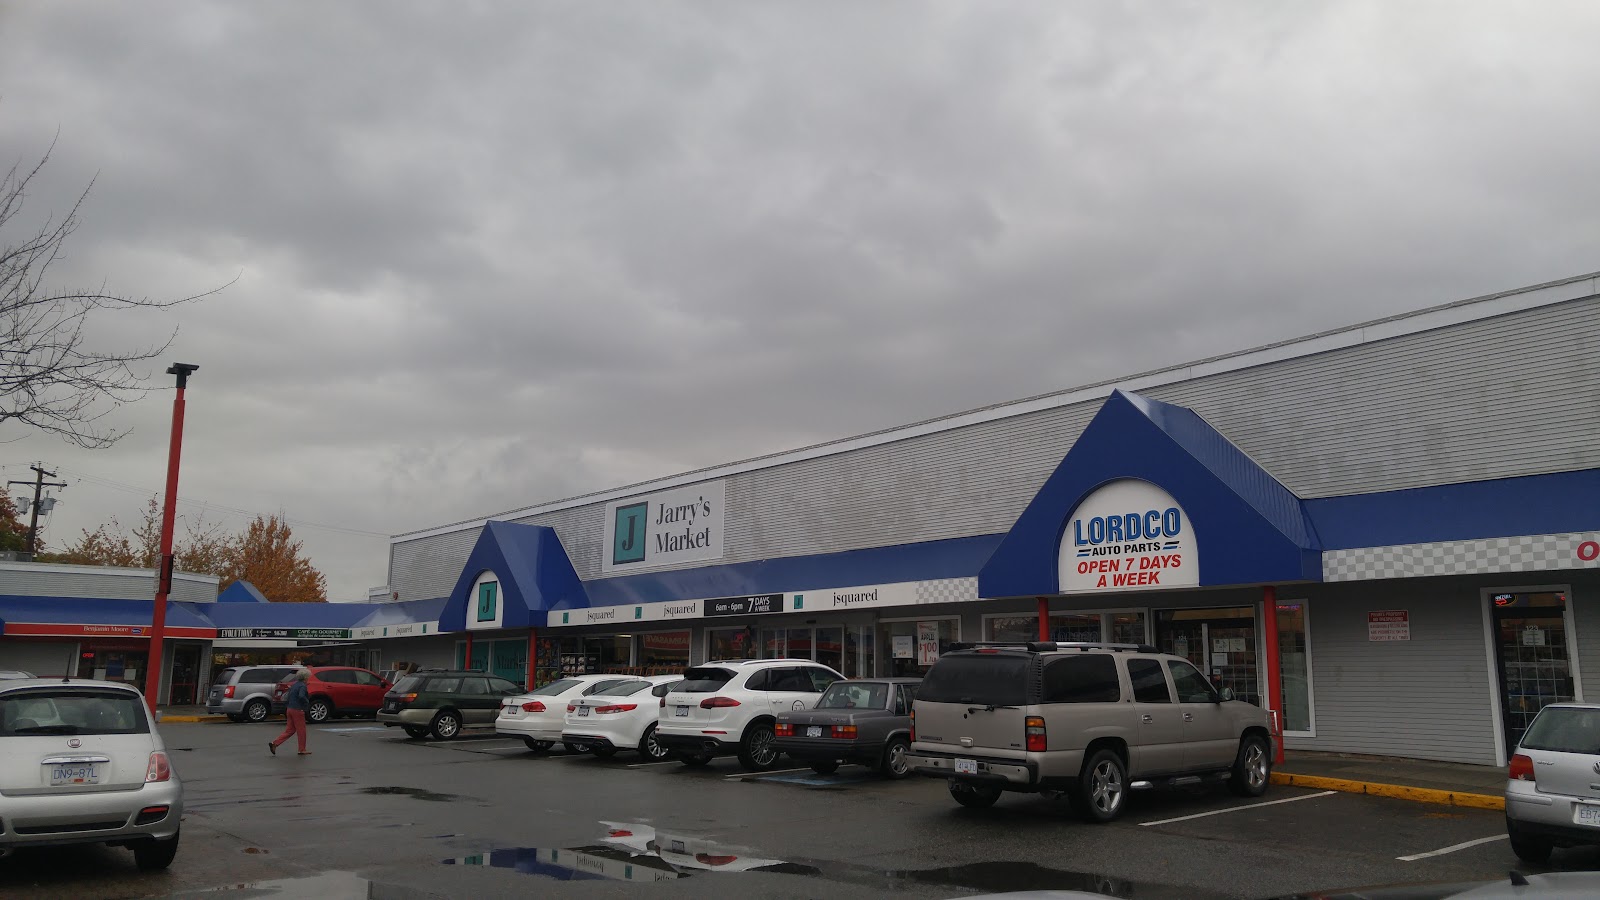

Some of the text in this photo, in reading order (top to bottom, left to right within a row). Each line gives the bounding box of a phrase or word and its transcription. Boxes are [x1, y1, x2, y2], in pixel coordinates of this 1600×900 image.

[656, 496, 711, 525] Jarry's
[622, 515, 638, 551] J
[1074, 508, 1181, 547] LORDCO
[656, 528, 711, 553] Market
[1092, 542, 1161, 556] AUTO PARTS
[1077, 555, 1182, 574] OPEN 7 DAYS
[1097, 571, 1161, 587] A WEEK
[483, 590, 492, 613] J
[715, 604, 728, 613] 6am
[731, 602, 744, 612] 6pm
[748, 598, 758, 612] 7
[755, 596, 770, 606] DAYS
[833, 589, 878, 606] jsquared
[587, 609, 615, 622] jsquared
[664, 603, 696, 617] jsquared
[1581, 809, 1600, 820] EB7
